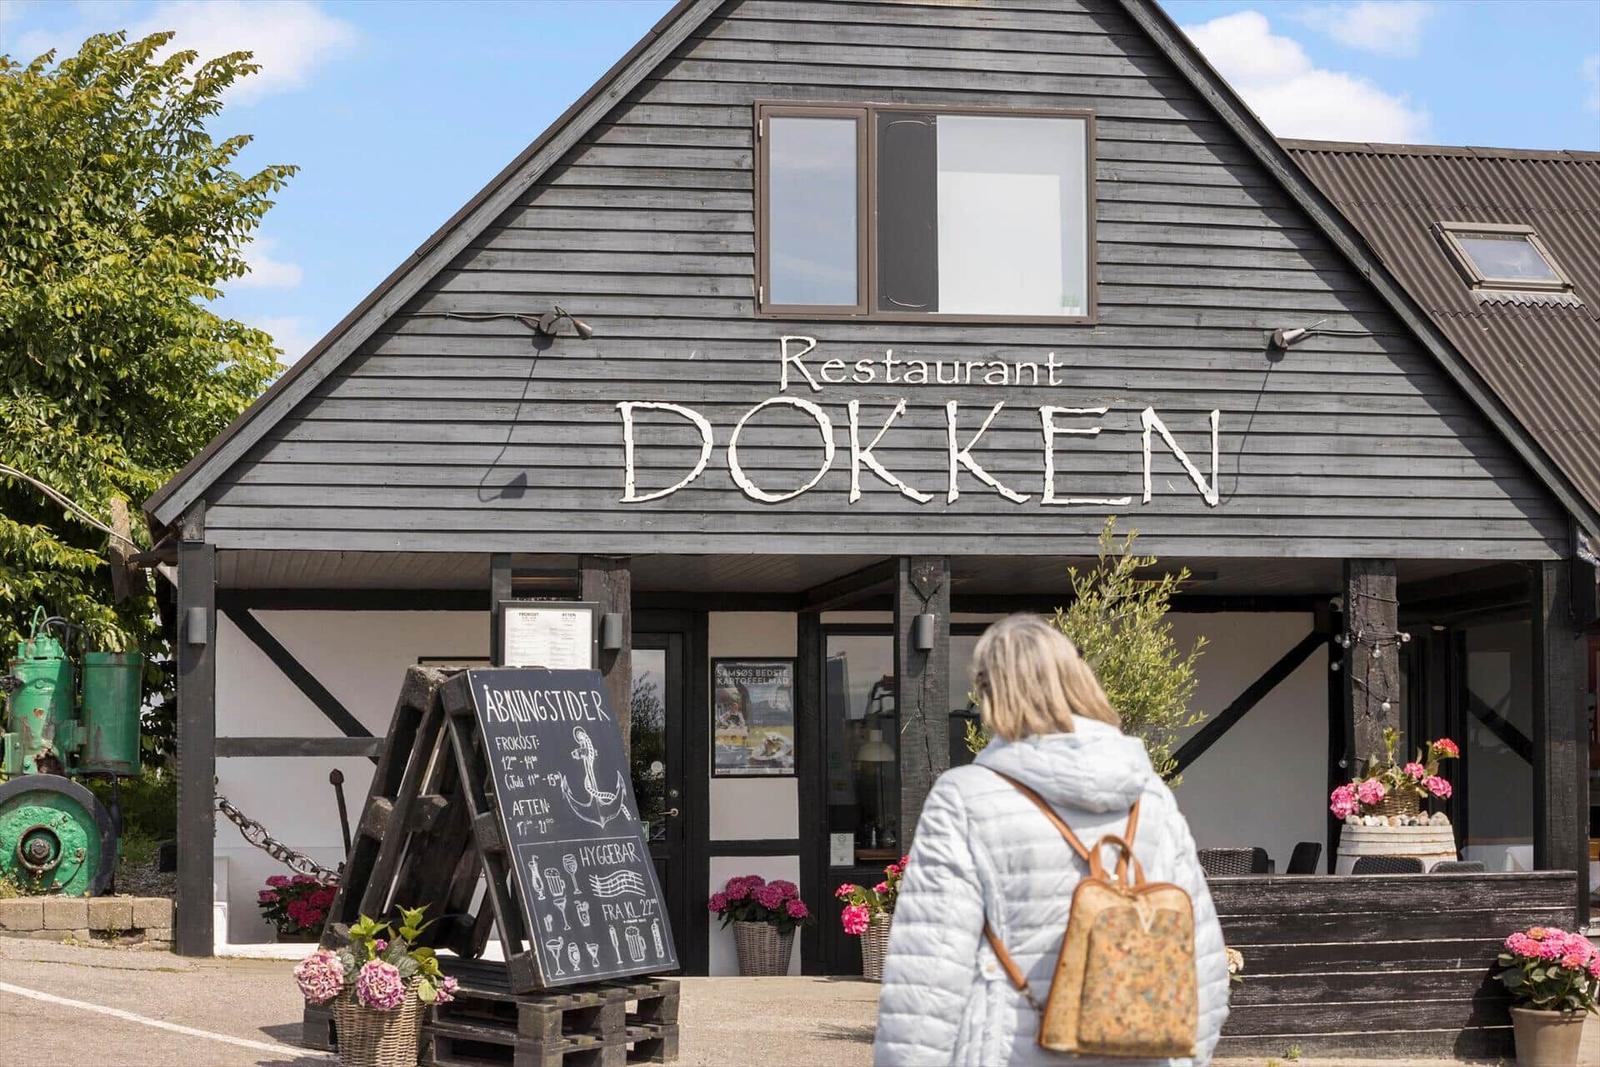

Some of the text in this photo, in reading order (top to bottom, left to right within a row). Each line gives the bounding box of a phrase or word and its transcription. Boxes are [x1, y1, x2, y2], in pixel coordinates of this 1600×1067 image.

[779, 335, 1064, 393] Restaurant
[616, 396, 1221, 508] DOKKEN
[717, 668, 789, 677] SAMSØS BEDSTE
[717, 677, 789, 686] KARTOFFELMAD
[483, 684, 611, 723] ÅBNINGSTIDER
[495, 735, 540, 752] FROKOST:
[513, 799, 551, 817] AFTEN:
[579, 842, 642, 868] HYGGEBAR
[601, 903, 625, 921] FRA
